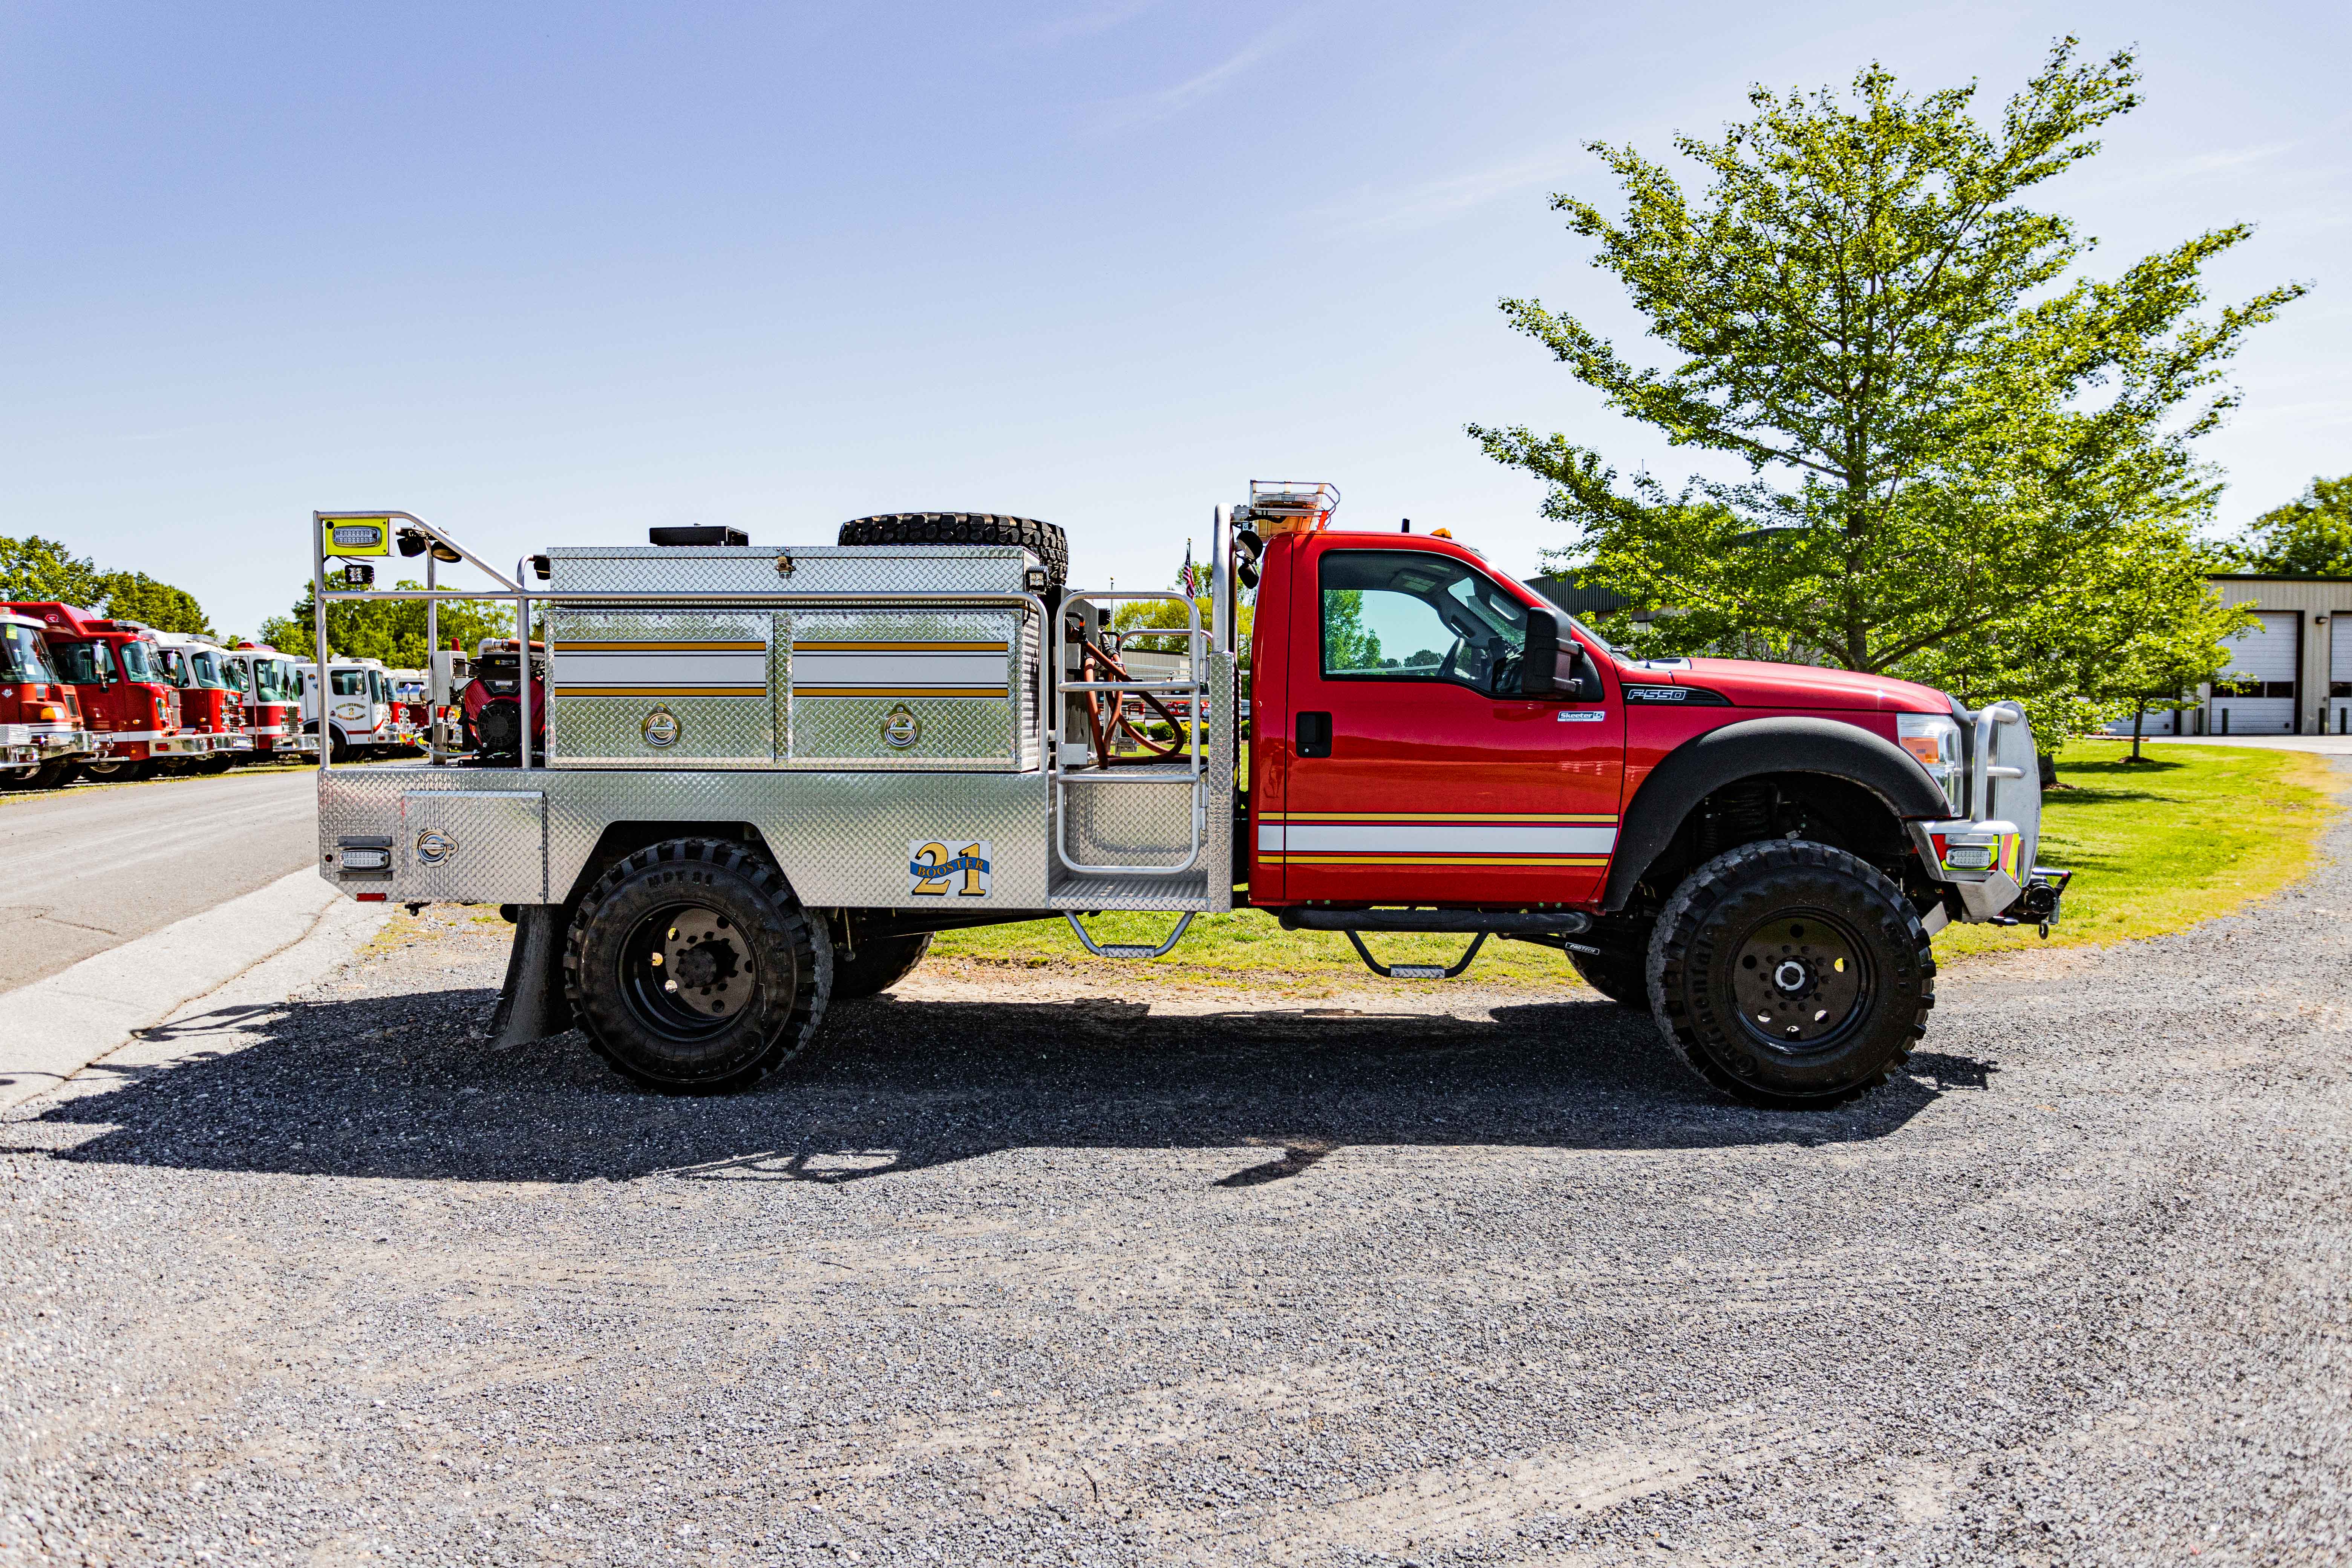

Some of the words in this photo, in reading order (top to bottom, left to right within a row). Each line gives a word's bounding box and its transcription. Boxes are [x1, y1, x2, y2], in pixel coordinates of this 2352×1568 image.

[1627, 689, 1686, 700] F-550
[911, 842, 986, 896] 21
[917, 859, 983, 877] BOOSTER
